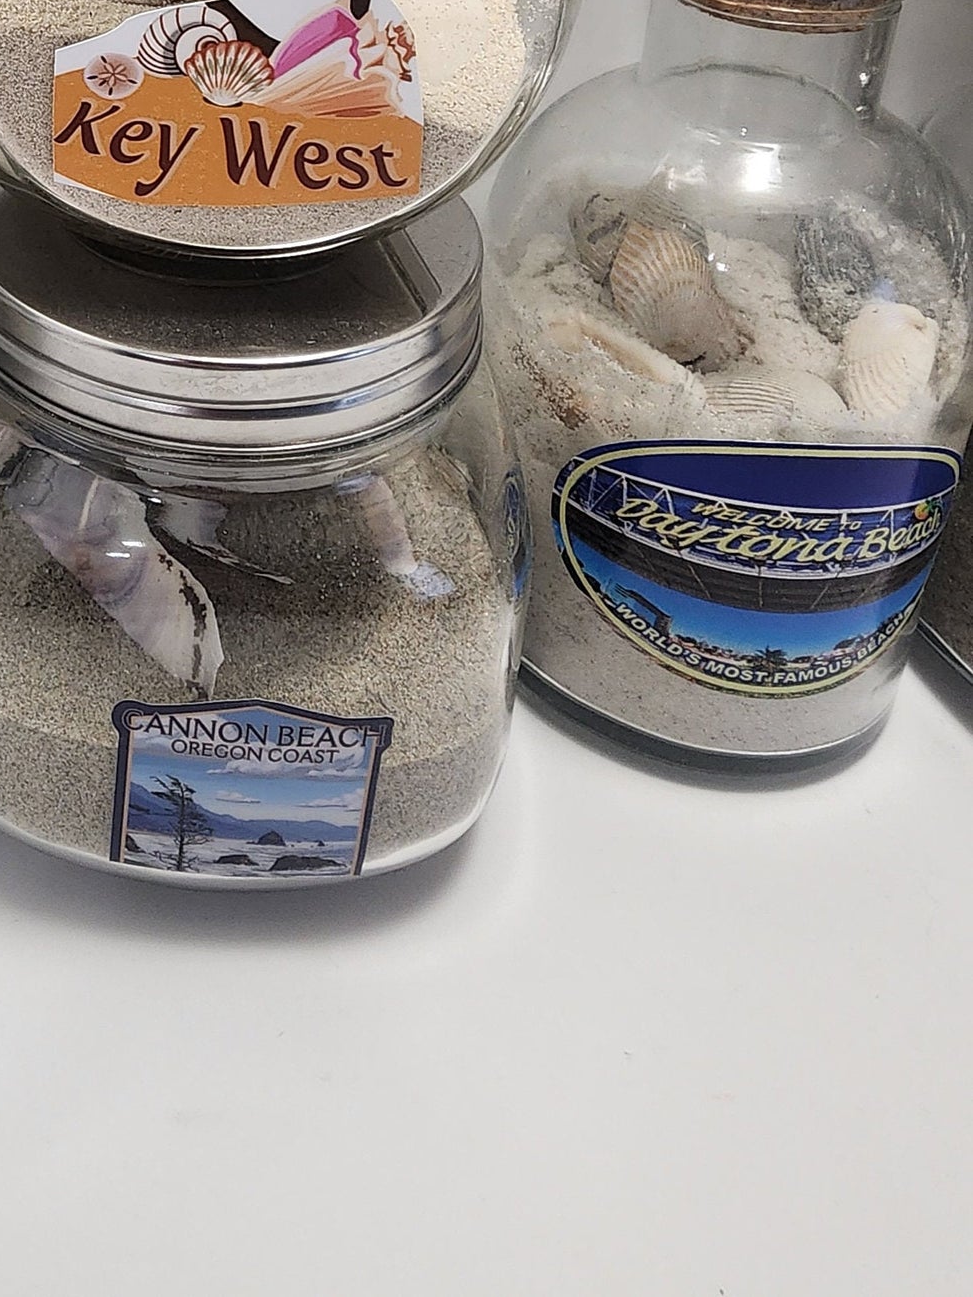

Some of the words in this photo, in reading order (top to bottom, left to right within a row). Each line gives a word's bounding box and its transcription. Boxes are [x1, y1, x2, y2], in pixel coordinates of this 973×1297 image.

[54, 102, 199, 196] Key
[220, 117, 408, 190] West
[616, 498, 855, 562] Daytona
[858, 507, 941, 559] Beach
[691, 503, 836, 531] WELCOME
[617, 603, 702, 666] WORLD'S
[705, 660, 769, 683] MOST
[773, 656, 853, 683] FAMOUS
[857, 612, 904, 660] BEACH
[122, 709, 269, 747] CANNON
[276, 725, 387, 748] BEACH
[171, 739, 263, 762] OREGON
[268, 748, 340, 764] COAST
